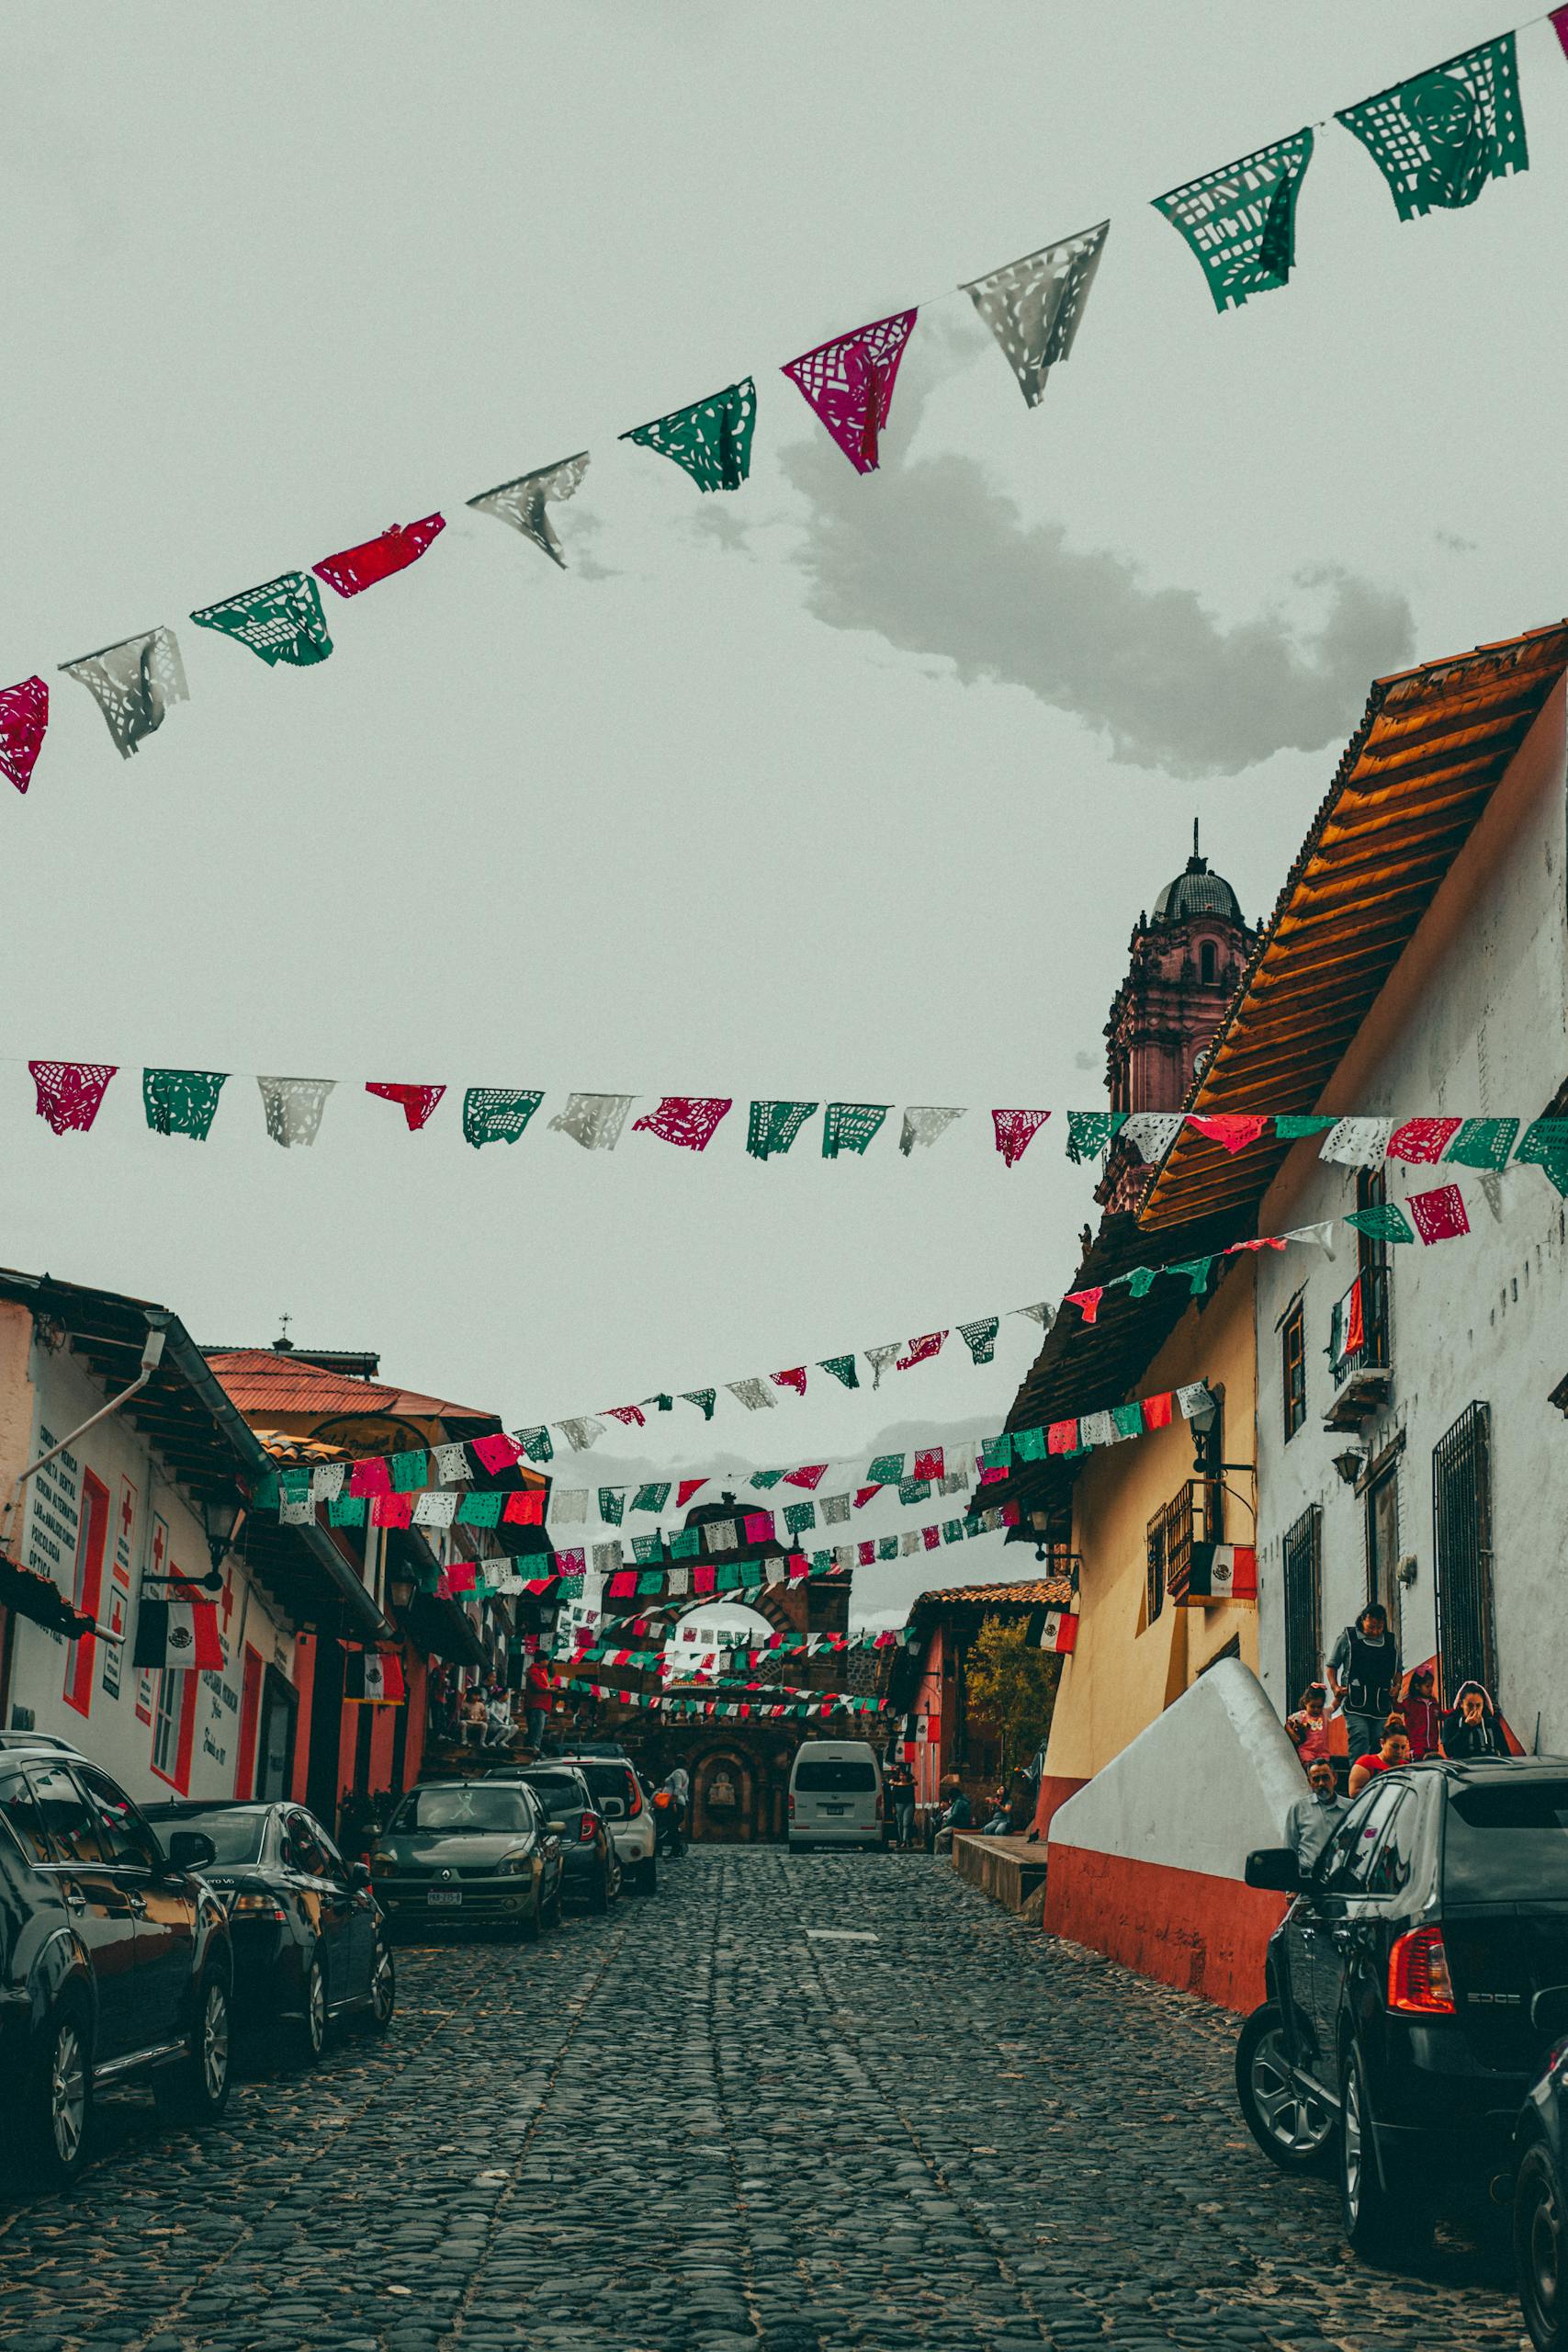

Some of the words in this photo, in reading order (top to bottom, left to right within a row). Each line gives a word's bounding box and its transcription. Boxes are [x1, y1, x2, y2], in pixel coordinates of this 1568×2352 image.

[36, 1474, 52, 1502] MEDICINA
[52, 1492, 77, 1529] ALTERNATIVA
[59, 1472, 75, 1500] DENTAL
[31, 1523, 60, 1564] PSICOLOGÍA
[29, 1544, 51, 1578] ÓPTICA
[1468, 1993, 1520, 2004] EDGE
